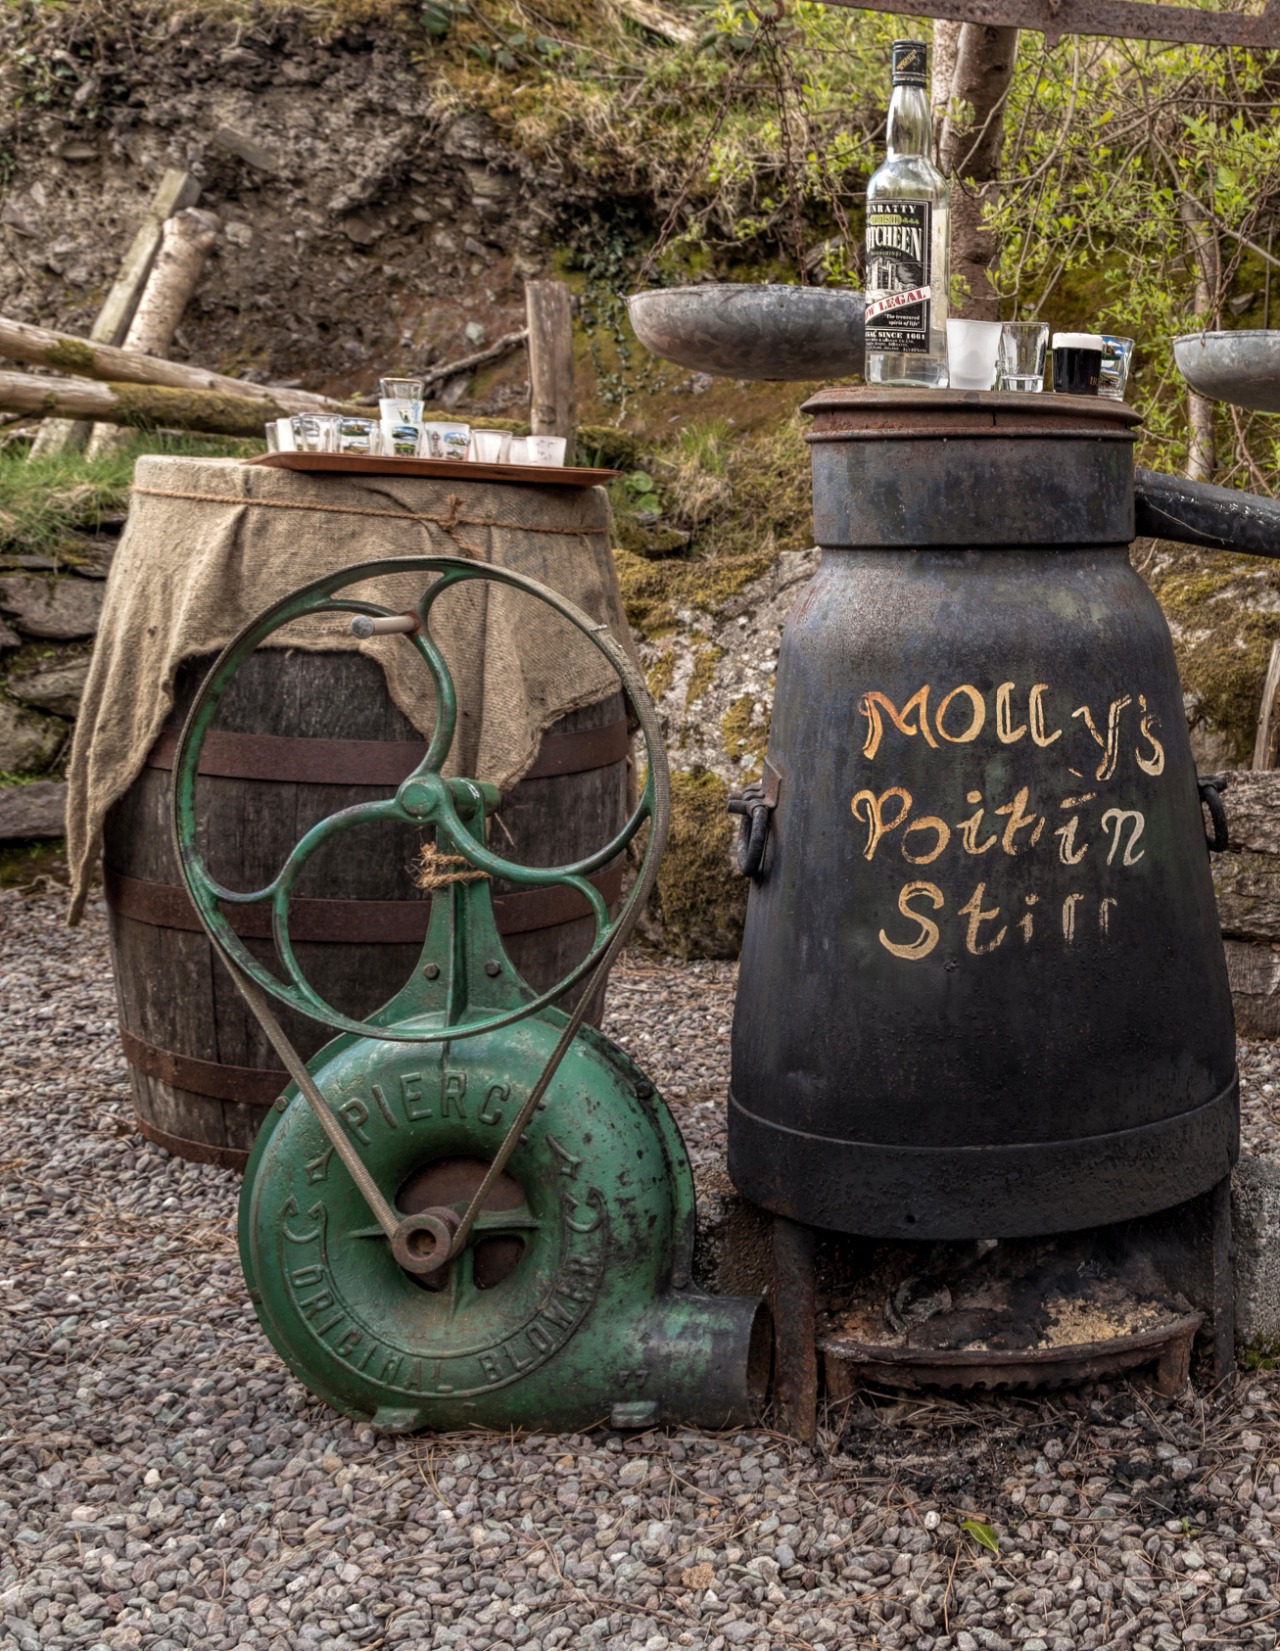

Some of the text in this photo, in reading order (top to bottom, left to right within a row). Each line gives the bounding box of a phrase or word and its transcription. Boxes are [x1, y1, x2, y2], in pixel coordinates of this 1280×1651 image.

[878, 290, 926, 311] LEGAL
[878, 331, 903, 339] SINCE
[291, 1263, 455, 1394] ORIGINAL
